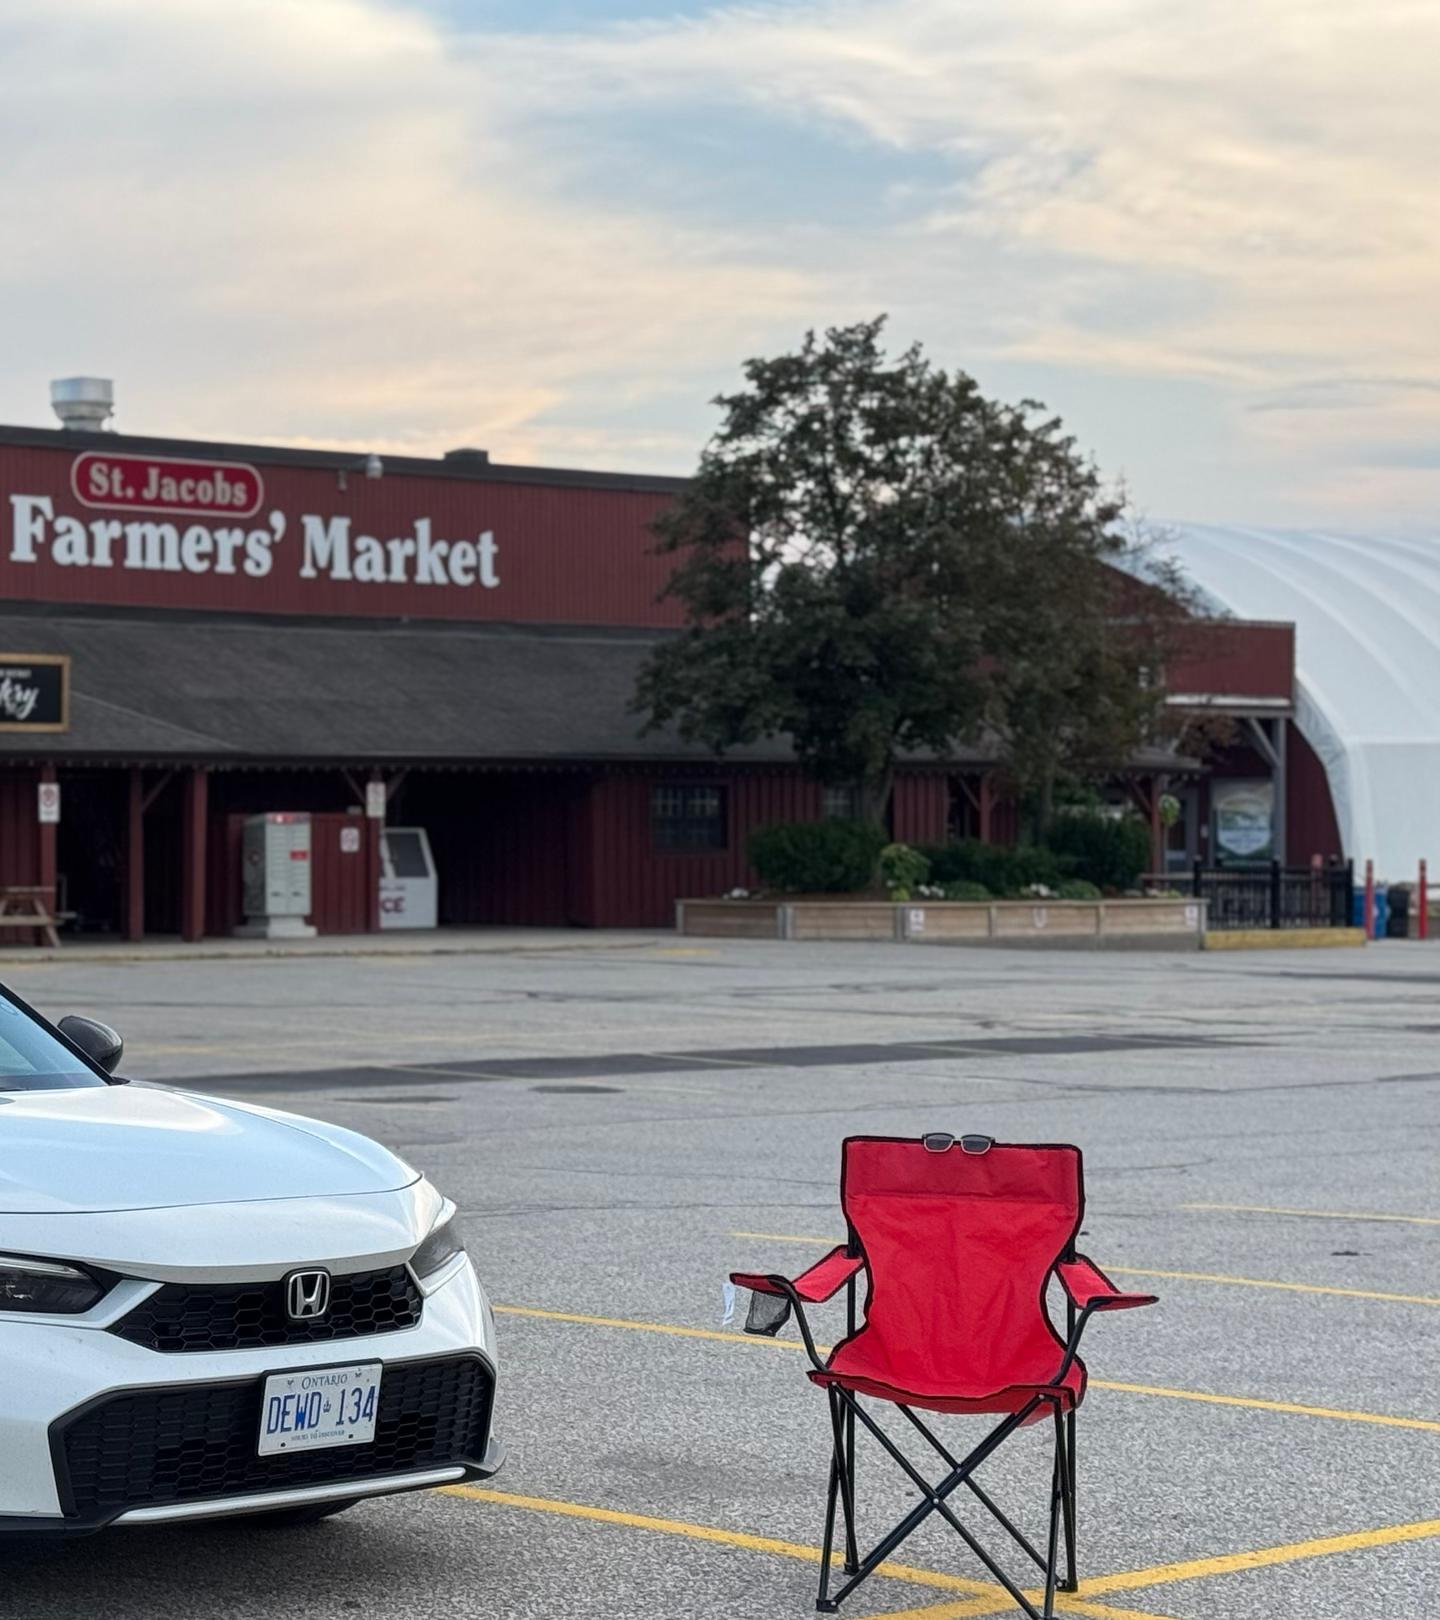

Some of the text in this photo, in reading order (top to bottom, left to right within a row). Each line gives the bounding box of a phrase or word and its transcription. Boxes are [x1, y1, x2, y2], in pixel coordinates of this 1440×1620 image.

[88, 461, 248, 507] St. Jacobs
[9, 494, 500, 588] Farmers' Market
[301, 1373, 348, 1390] ONTARIO
[266, 1385, 376, 1435] DEWD 134
